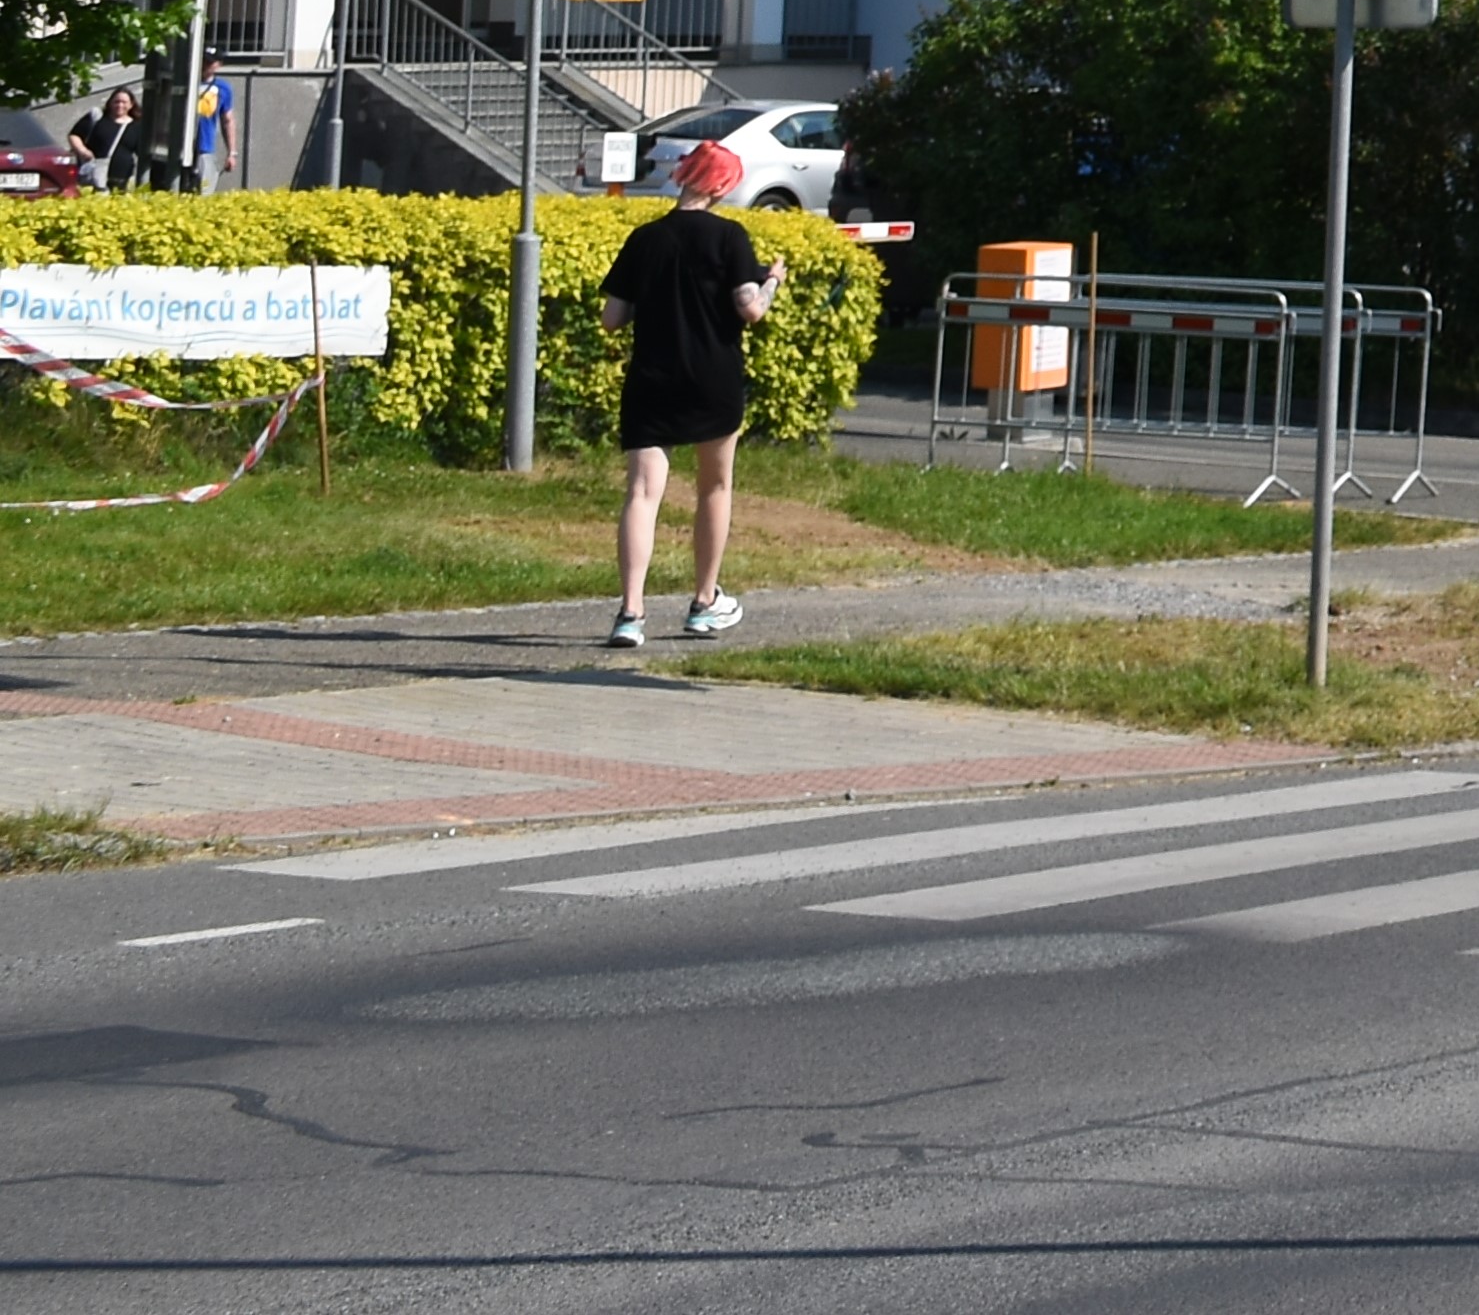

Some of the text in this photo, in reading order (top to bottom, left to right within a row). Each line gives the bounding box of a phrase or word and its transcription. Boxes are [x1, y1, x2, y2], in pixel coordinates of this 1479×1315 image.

[0, 289, 362, 330] Plavání kojenců a batolat
